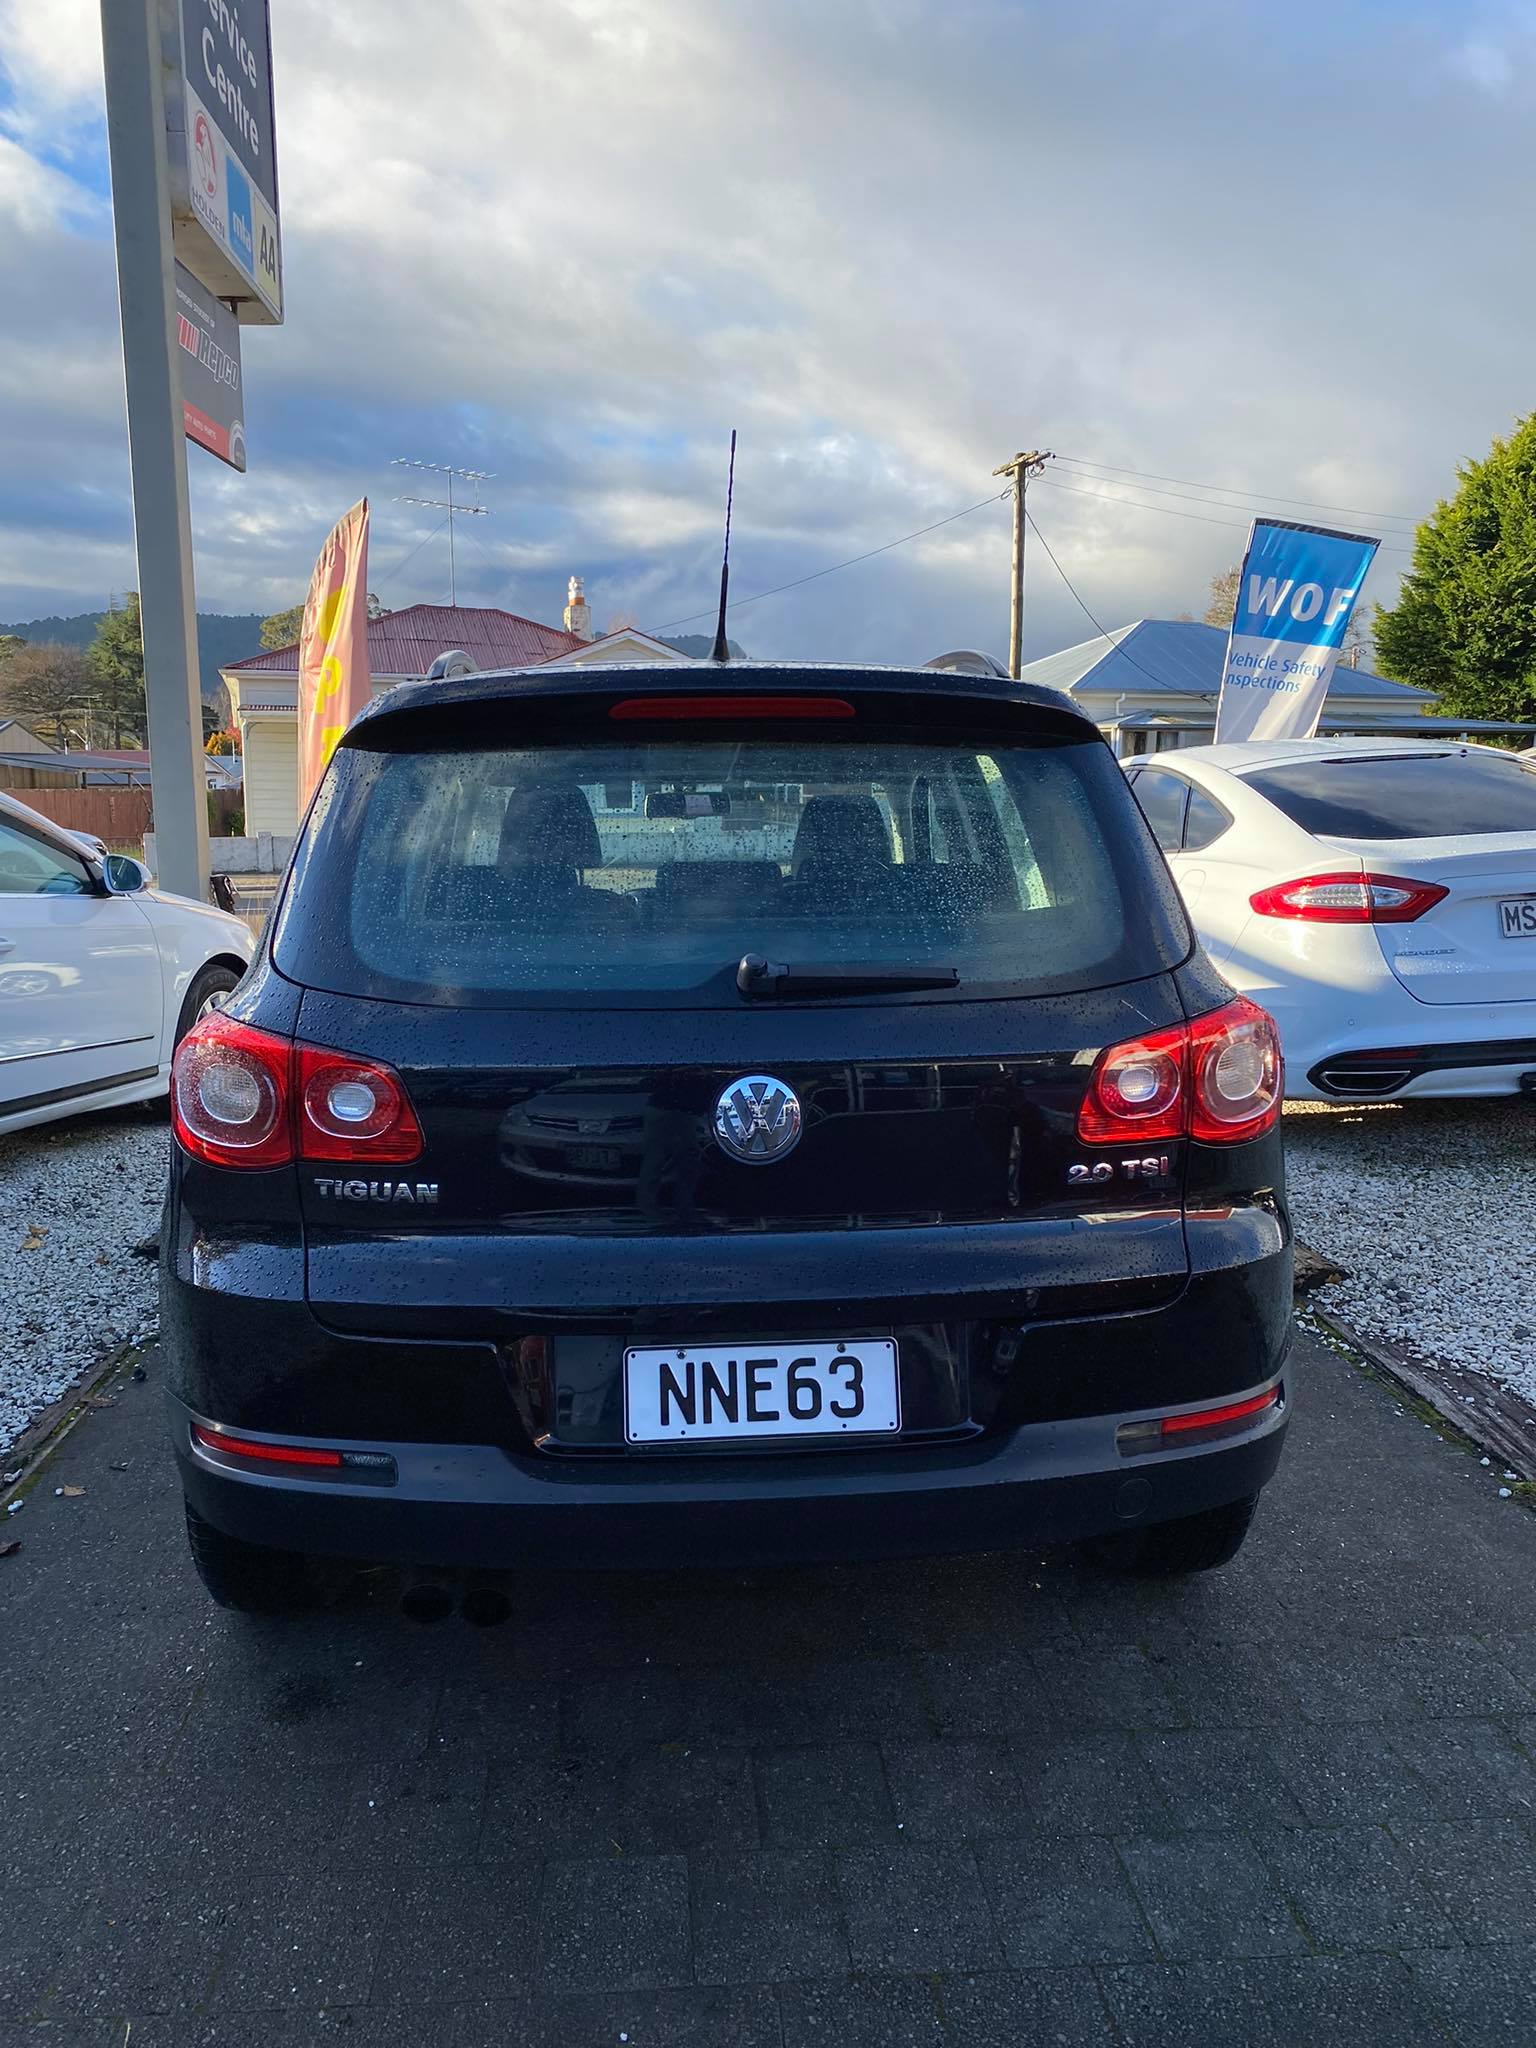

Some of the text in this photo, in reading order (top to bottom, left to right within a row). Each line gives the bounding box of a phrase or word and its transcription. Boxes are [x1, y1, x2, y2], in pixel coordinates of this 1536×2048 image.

[203, 0, 257, 88] ervice
[202, 27, 259, 156] Centre
[192, 186, 225, 238] HOLDEN
[260, 224, 276, 283] AA
[199, 328, 239, 391] Repco
[1247, 574, 1355, 627] WOF
[1225, 673, 1301, 693] nspections
[1229, 651, 1327, 681] Vehicle Safety
[1504, 905, 1536, 932] MS
[1121, 1156, 1169, 1180] TSI
[659, 1355, 865, 1426] NNE63
